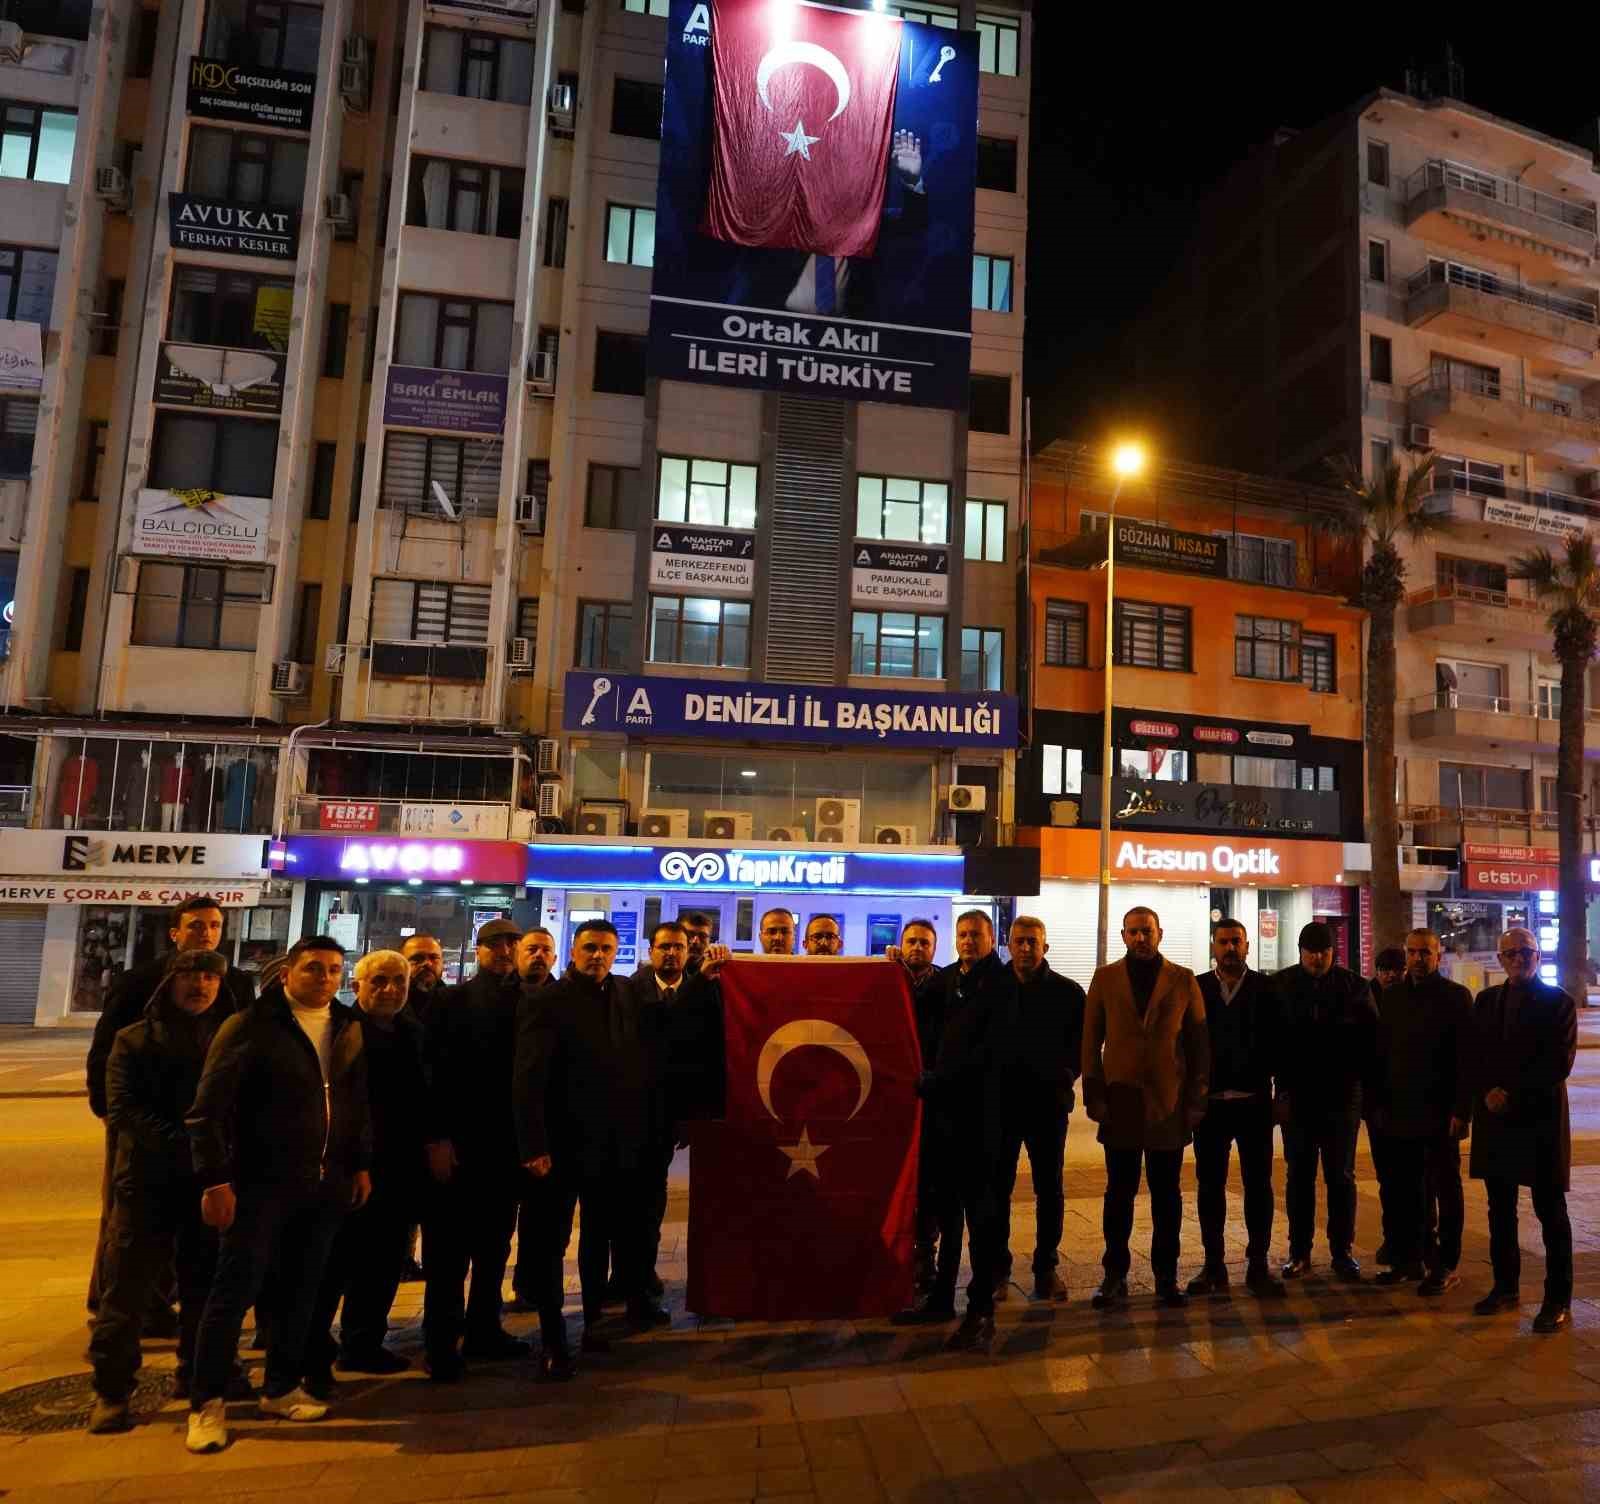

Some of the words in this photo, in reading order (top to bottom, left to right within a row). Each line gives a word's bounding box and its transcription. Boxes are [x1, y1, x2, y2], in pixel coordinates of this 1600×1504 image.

[683, 3, 710, 33] A
[290, 82, 312, 94] SON
[180, 203, 289, 232] AVUKAT
[180, 230, 234, 248] FERHAT
[239, 237, 289, 254] KESLER
[722, 315, 811, 346] Ortak
[818, 326, 879, 354] Akıl
[688, 343, 768, 378] İLERİ
[776, 356, 912, 393] TÜRKİYE
[441, 387, 500, 403] EMLAK
[657, 533, 672, 545] A
[682, 535, 734, 547] ANAHTAR
[857, 549, 871, 561] A
[880, 552, 928, 562] ANAHTAR
[665, 558, 747, 573] MERKEZEFENDİ
[657, 568, 681, 580] İLÇE
[871, 574, 932, 586] PAMUKKALE
[626, 687, 653, 714] A
[684, 690, 796, 727] DENİZLİ
[804, 695, 830, 728] İL
[837, 701, 1001, 737] BAŞKANLIĞI
[112, 843, 207, 865] MERVE
[1115, 841, 1207, 872] Atasun
[1212, 845, 1280, 879] Optik
[1478, 869, 1539, 885] etstur
[63, 888, 134, 903] ÇORAP
[136, 889, 153, 900] &
[158, 890, 244, 905] ÇAMAŞIR
